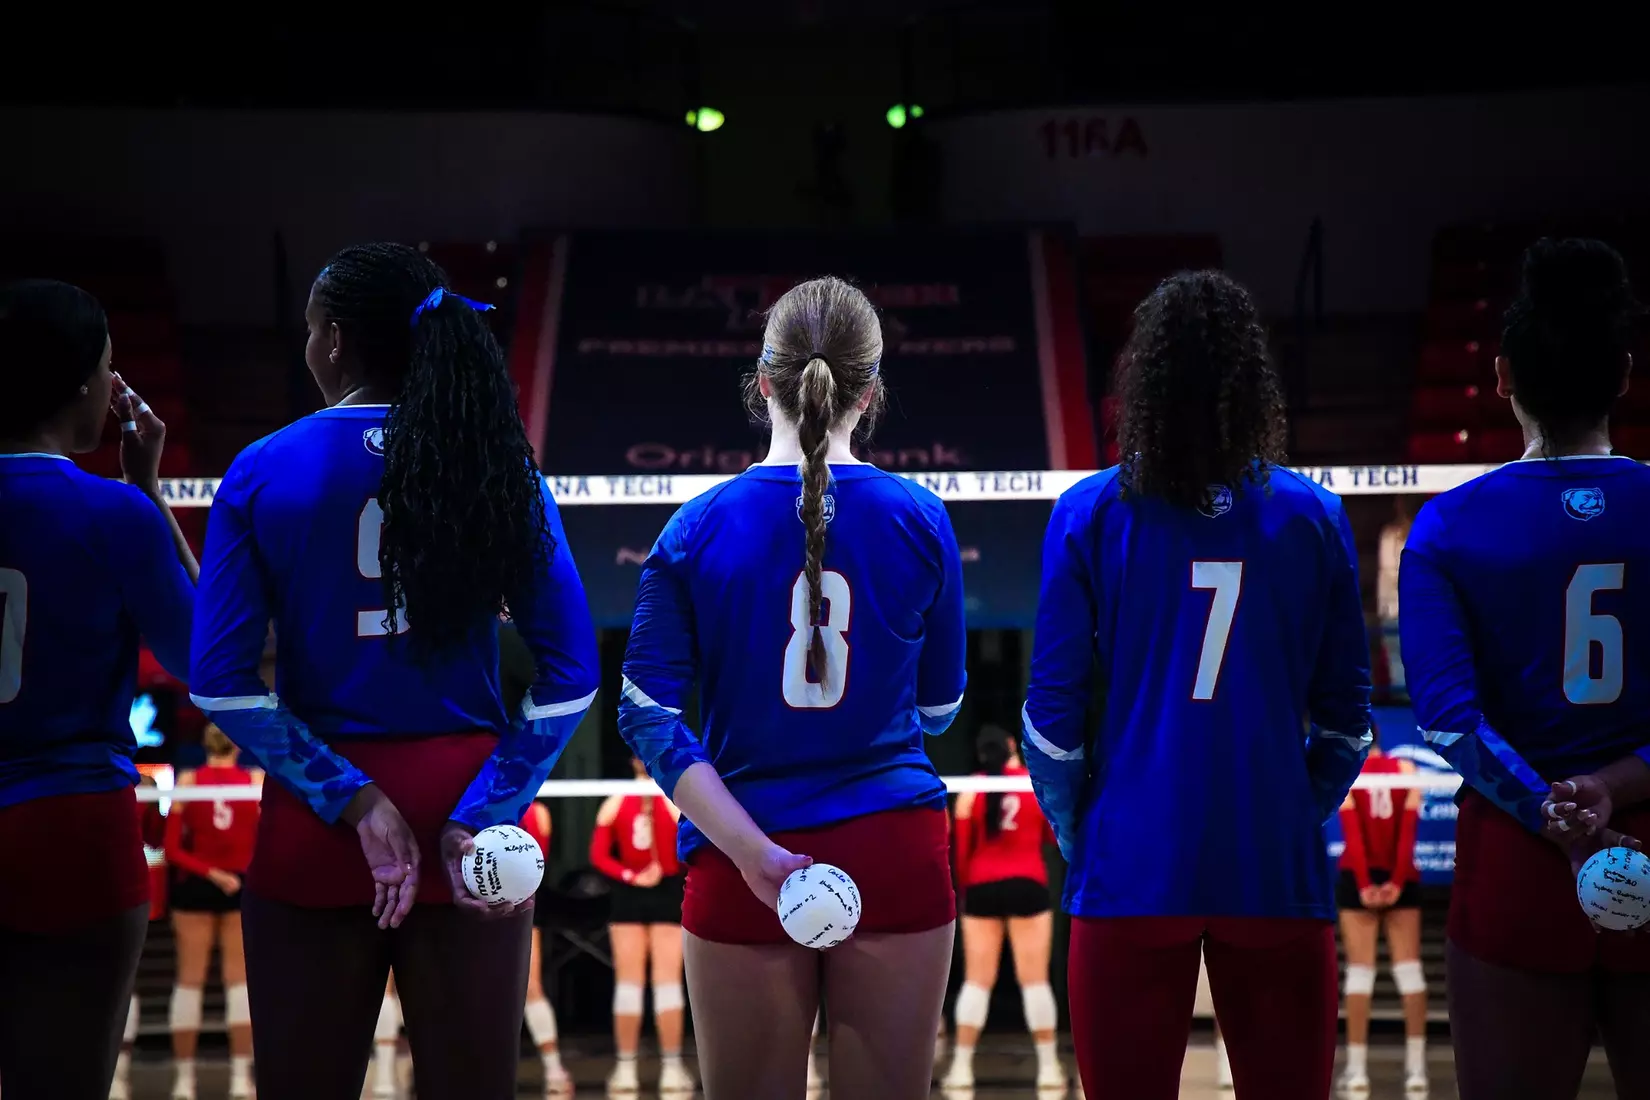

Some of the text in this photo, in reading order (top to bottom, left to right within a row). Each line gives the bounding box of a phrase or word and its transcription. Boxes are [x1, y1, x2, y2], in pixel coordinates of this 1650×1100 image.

[605, 475, 672, 496] TECH
[975, 472, 1042, 492] TECH
[1350, 465, 1419, 487] TECH
[782, 570, 851, 708] 8
[1192, 561, 1243, 699] 7
[1563, 563, 1625, 704] 6
[1000, 794, 1021, 832] 2
[473, 847, 488, 896] molten
